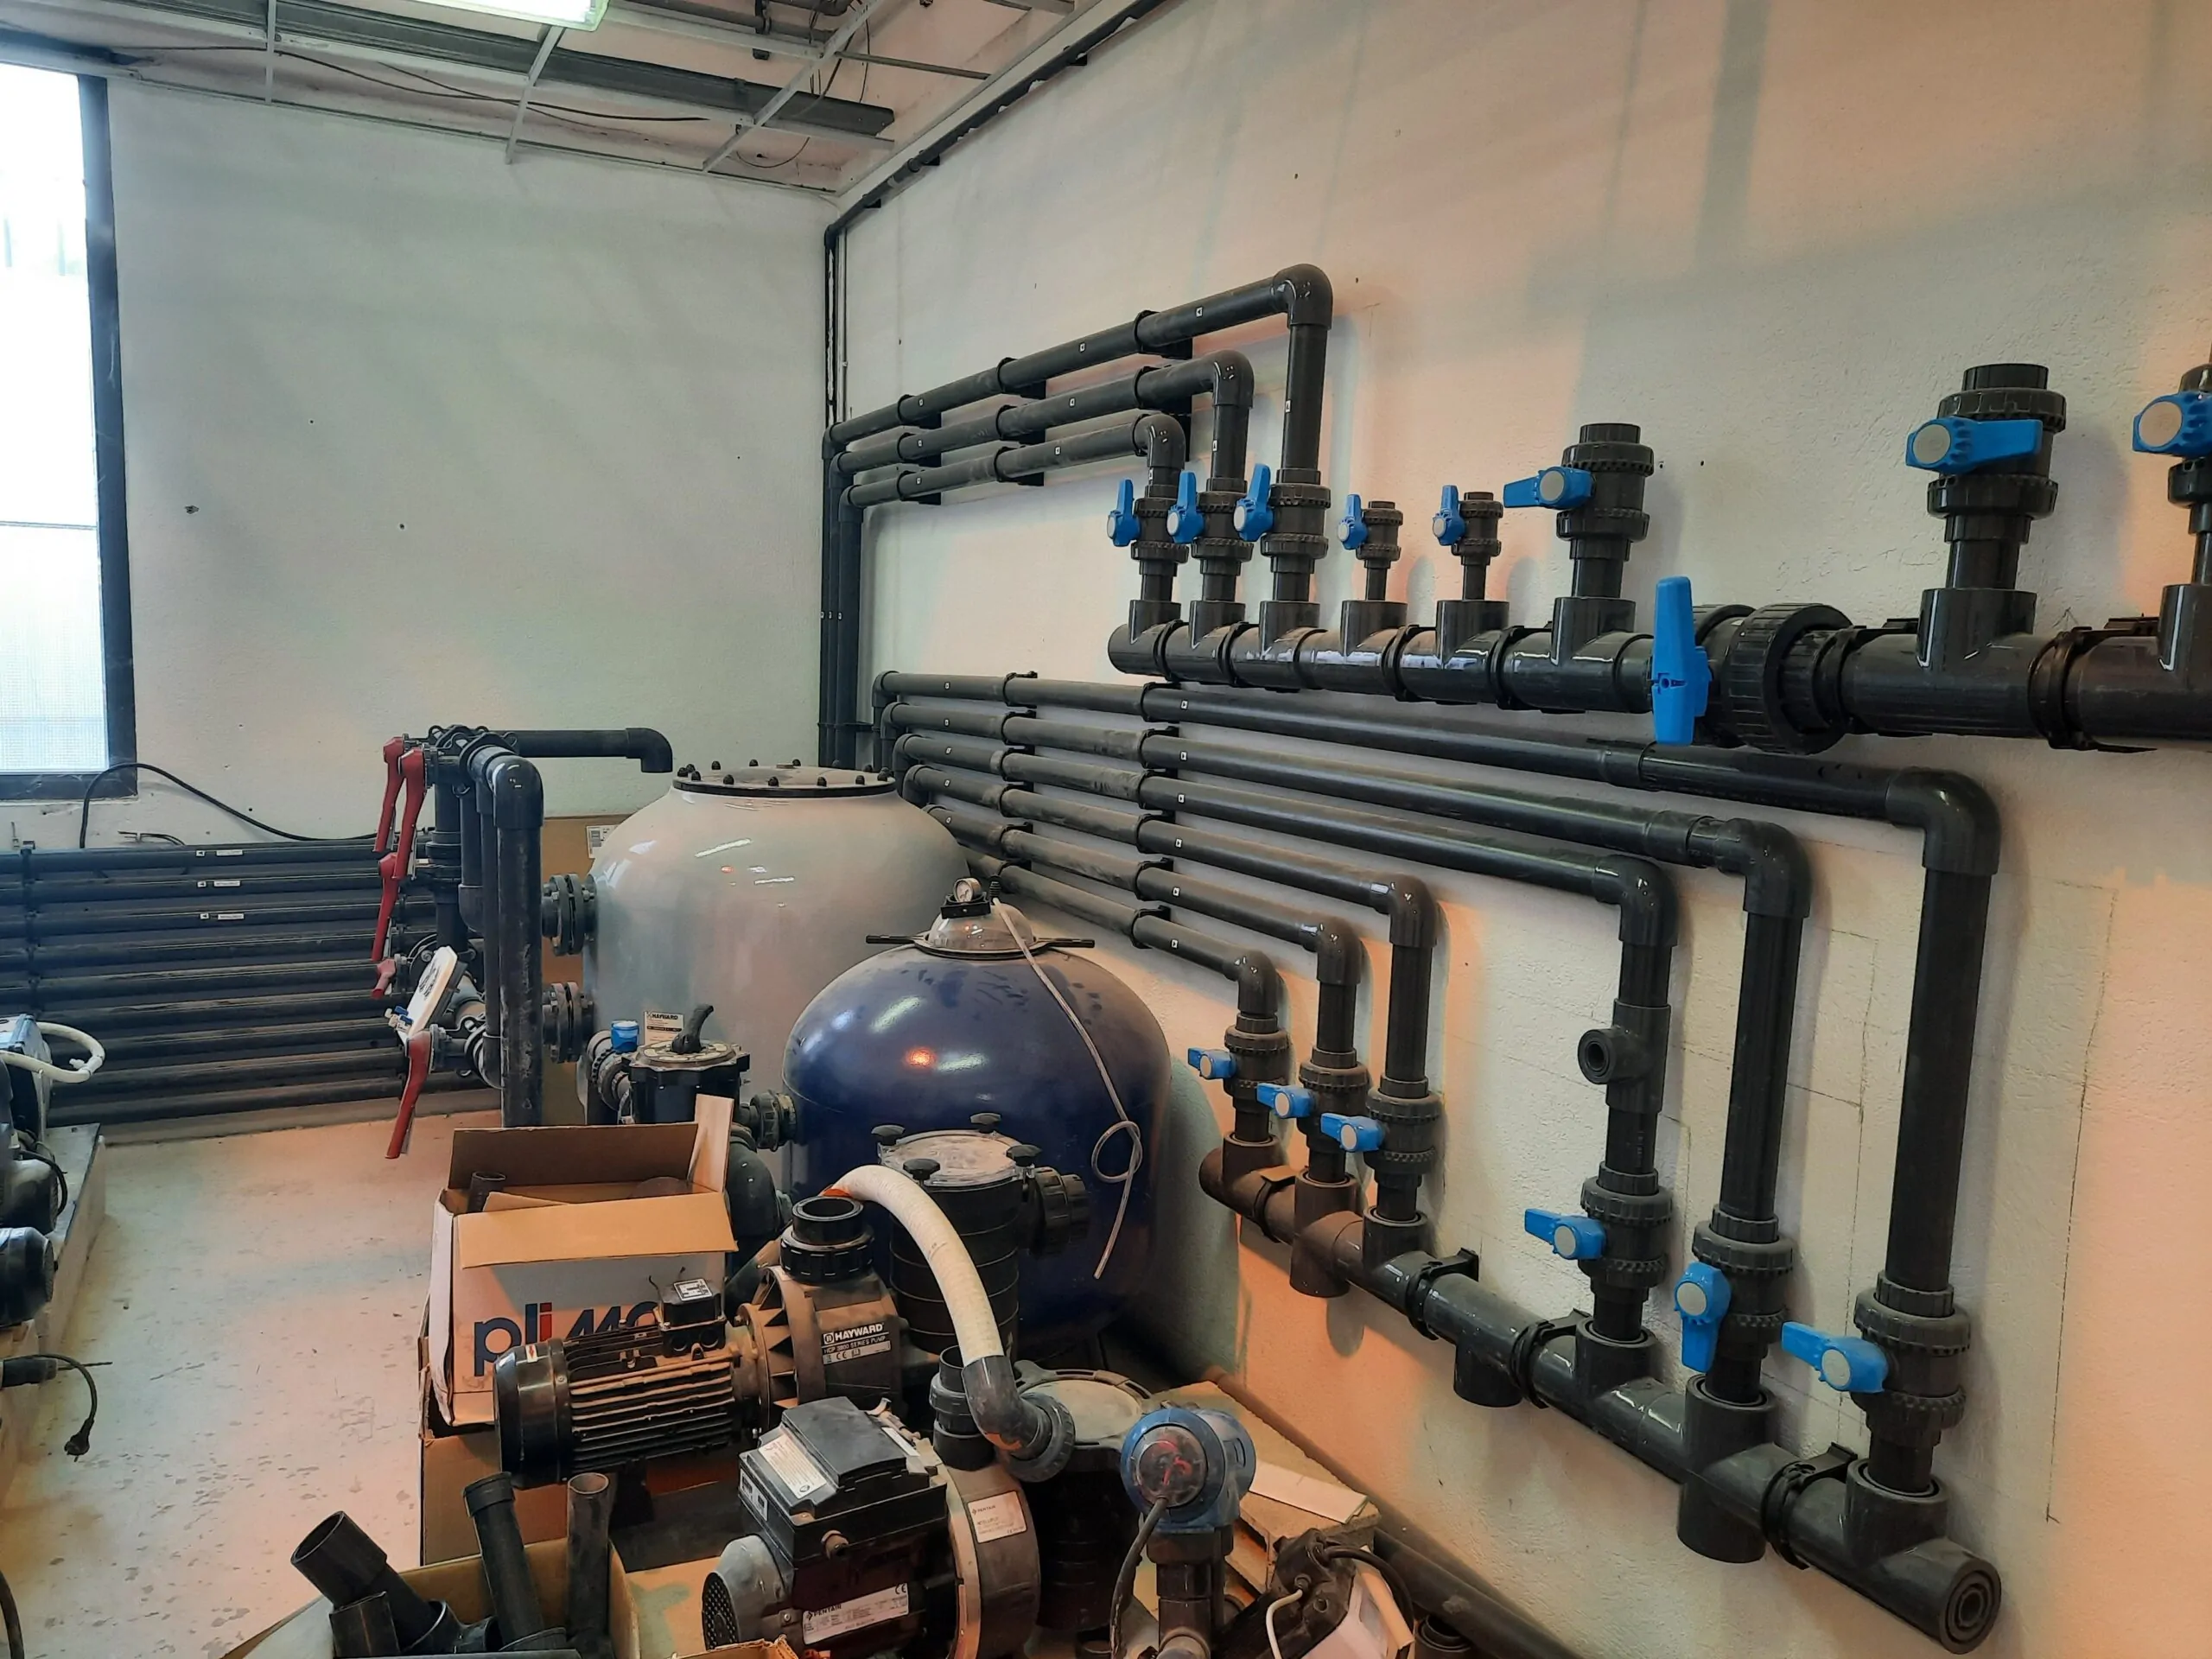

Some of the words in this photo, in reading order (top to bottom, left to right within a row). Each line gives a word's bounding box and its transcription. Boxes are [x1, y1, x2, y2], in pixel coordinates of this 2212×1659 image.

[835, 1323, 883, 1340] HAYWARD
[850, 1339, 869, 1348] SERIES
[870, 1335, 886, 1344] PUMP
[813, 1604, 842, 1618] PENTAIR
